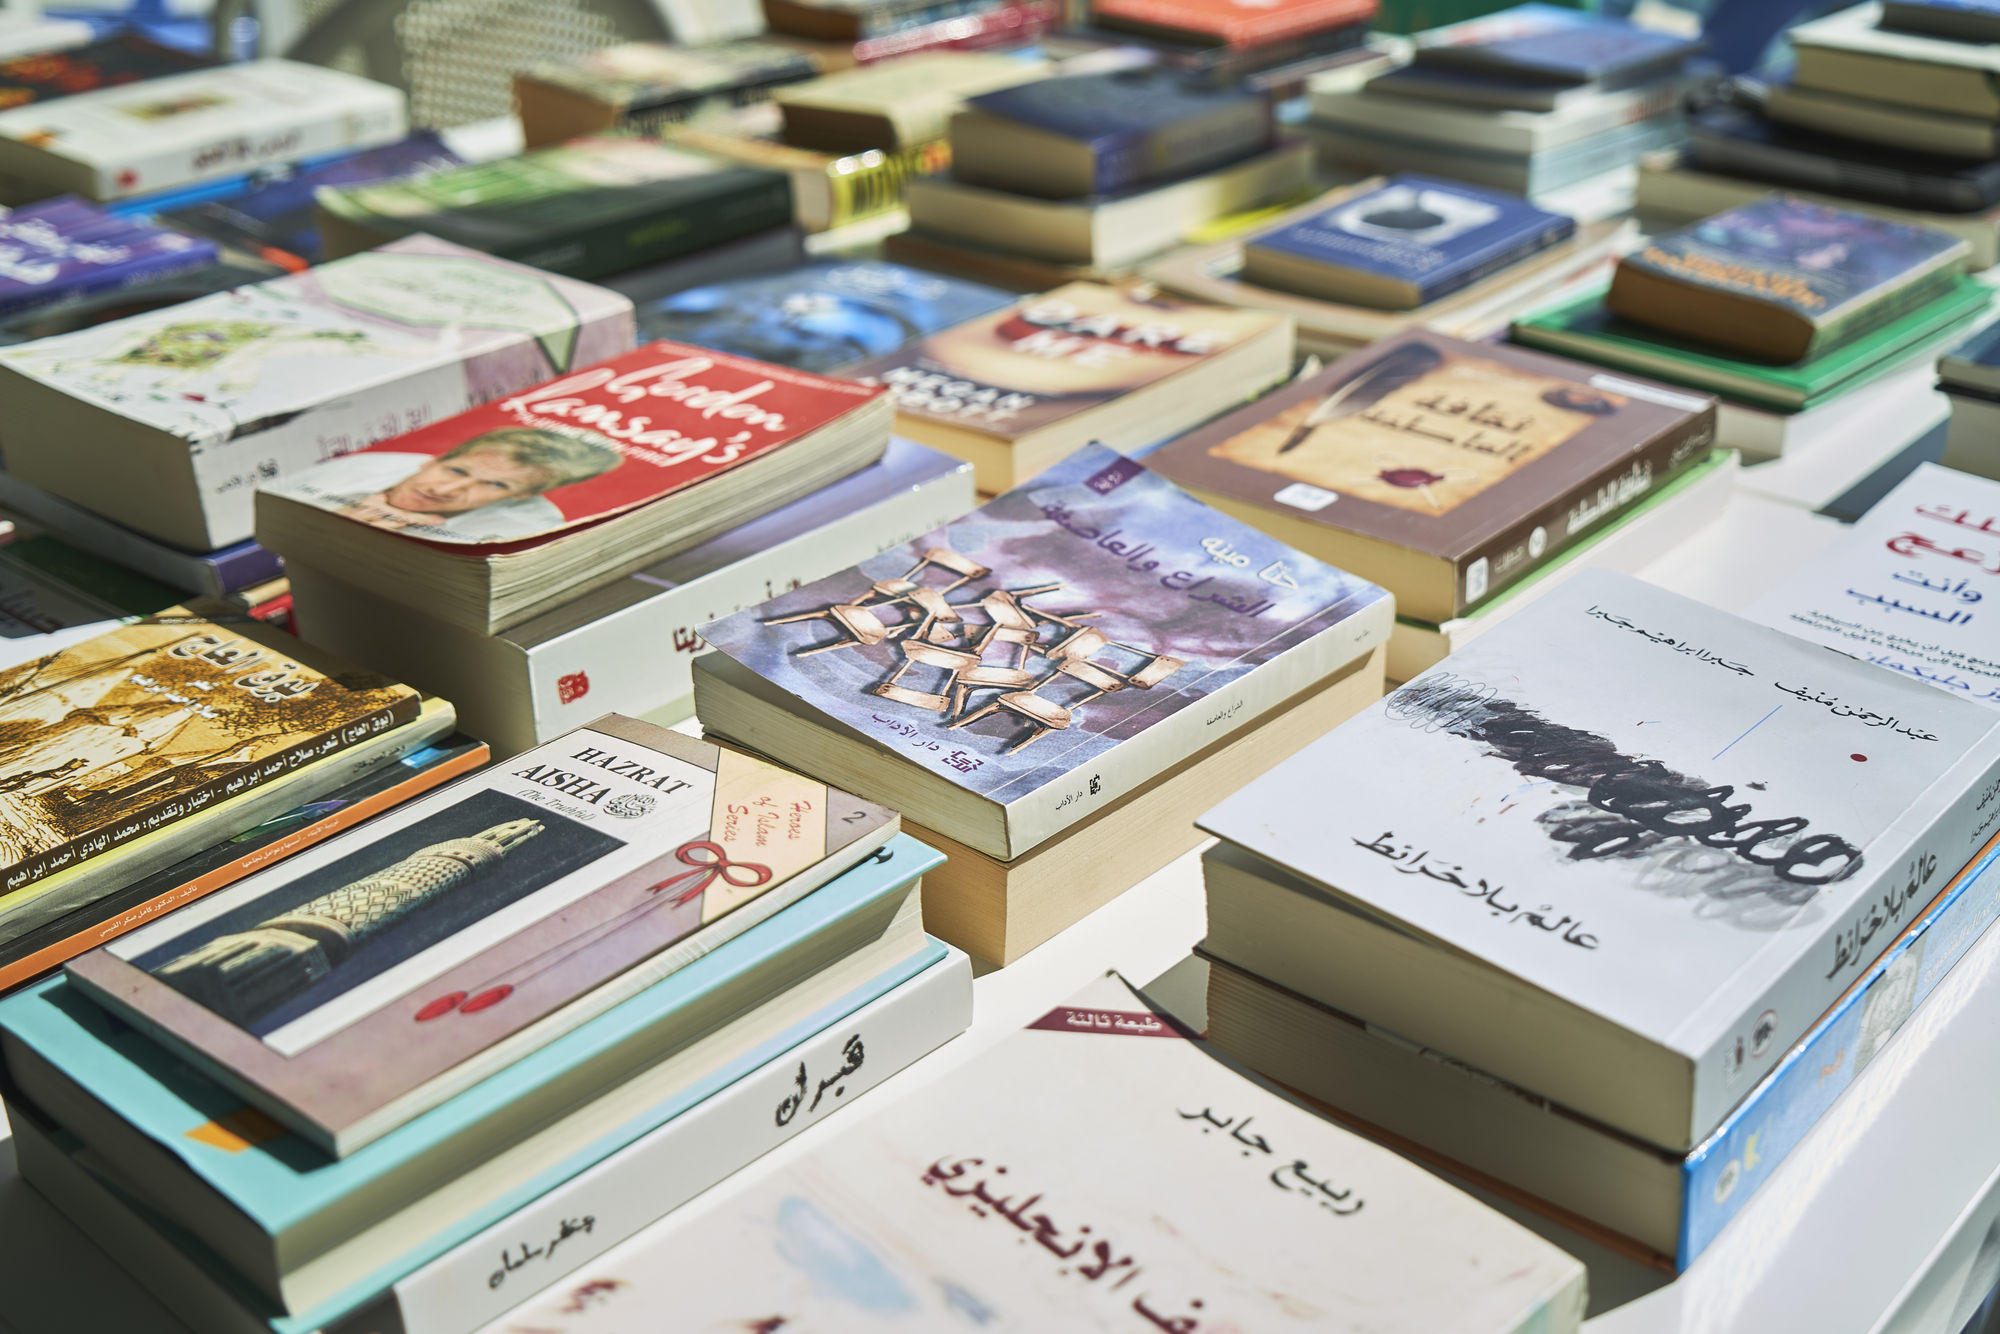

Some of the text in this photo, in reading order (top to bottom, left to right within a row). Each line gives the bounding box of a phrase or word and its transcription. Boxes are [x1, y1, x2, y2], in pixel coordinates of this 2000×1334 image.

[1846, 588, 1974, 626] السبب
[263, 755, 288, 776] أحمد
[288, 748, 314, 768] صلاح
[569, 747, 694, 795] HAZRAT
[226, 769, 262, 795] إبراهيم
[511, 764, 612, 805] AISHA
[186, 788, 215, 813] اختيار
[752, 796, 778, 808] of
[723, 803, 749, 843] Series
[755, 811, 780, 848] Islam
[841, 810, 867, 825] 2
[113, 824, 140, 841] محمد
[50, 846, 76, 869] أحمد
[79, 834, 111, 860] الهادي
[6, 861, 48, 890] إبراهيم
[1066, 1010, 1162, 1032] طبعة ثالثة
[1176, 1105, 1365, 1217] ربيع جابر
